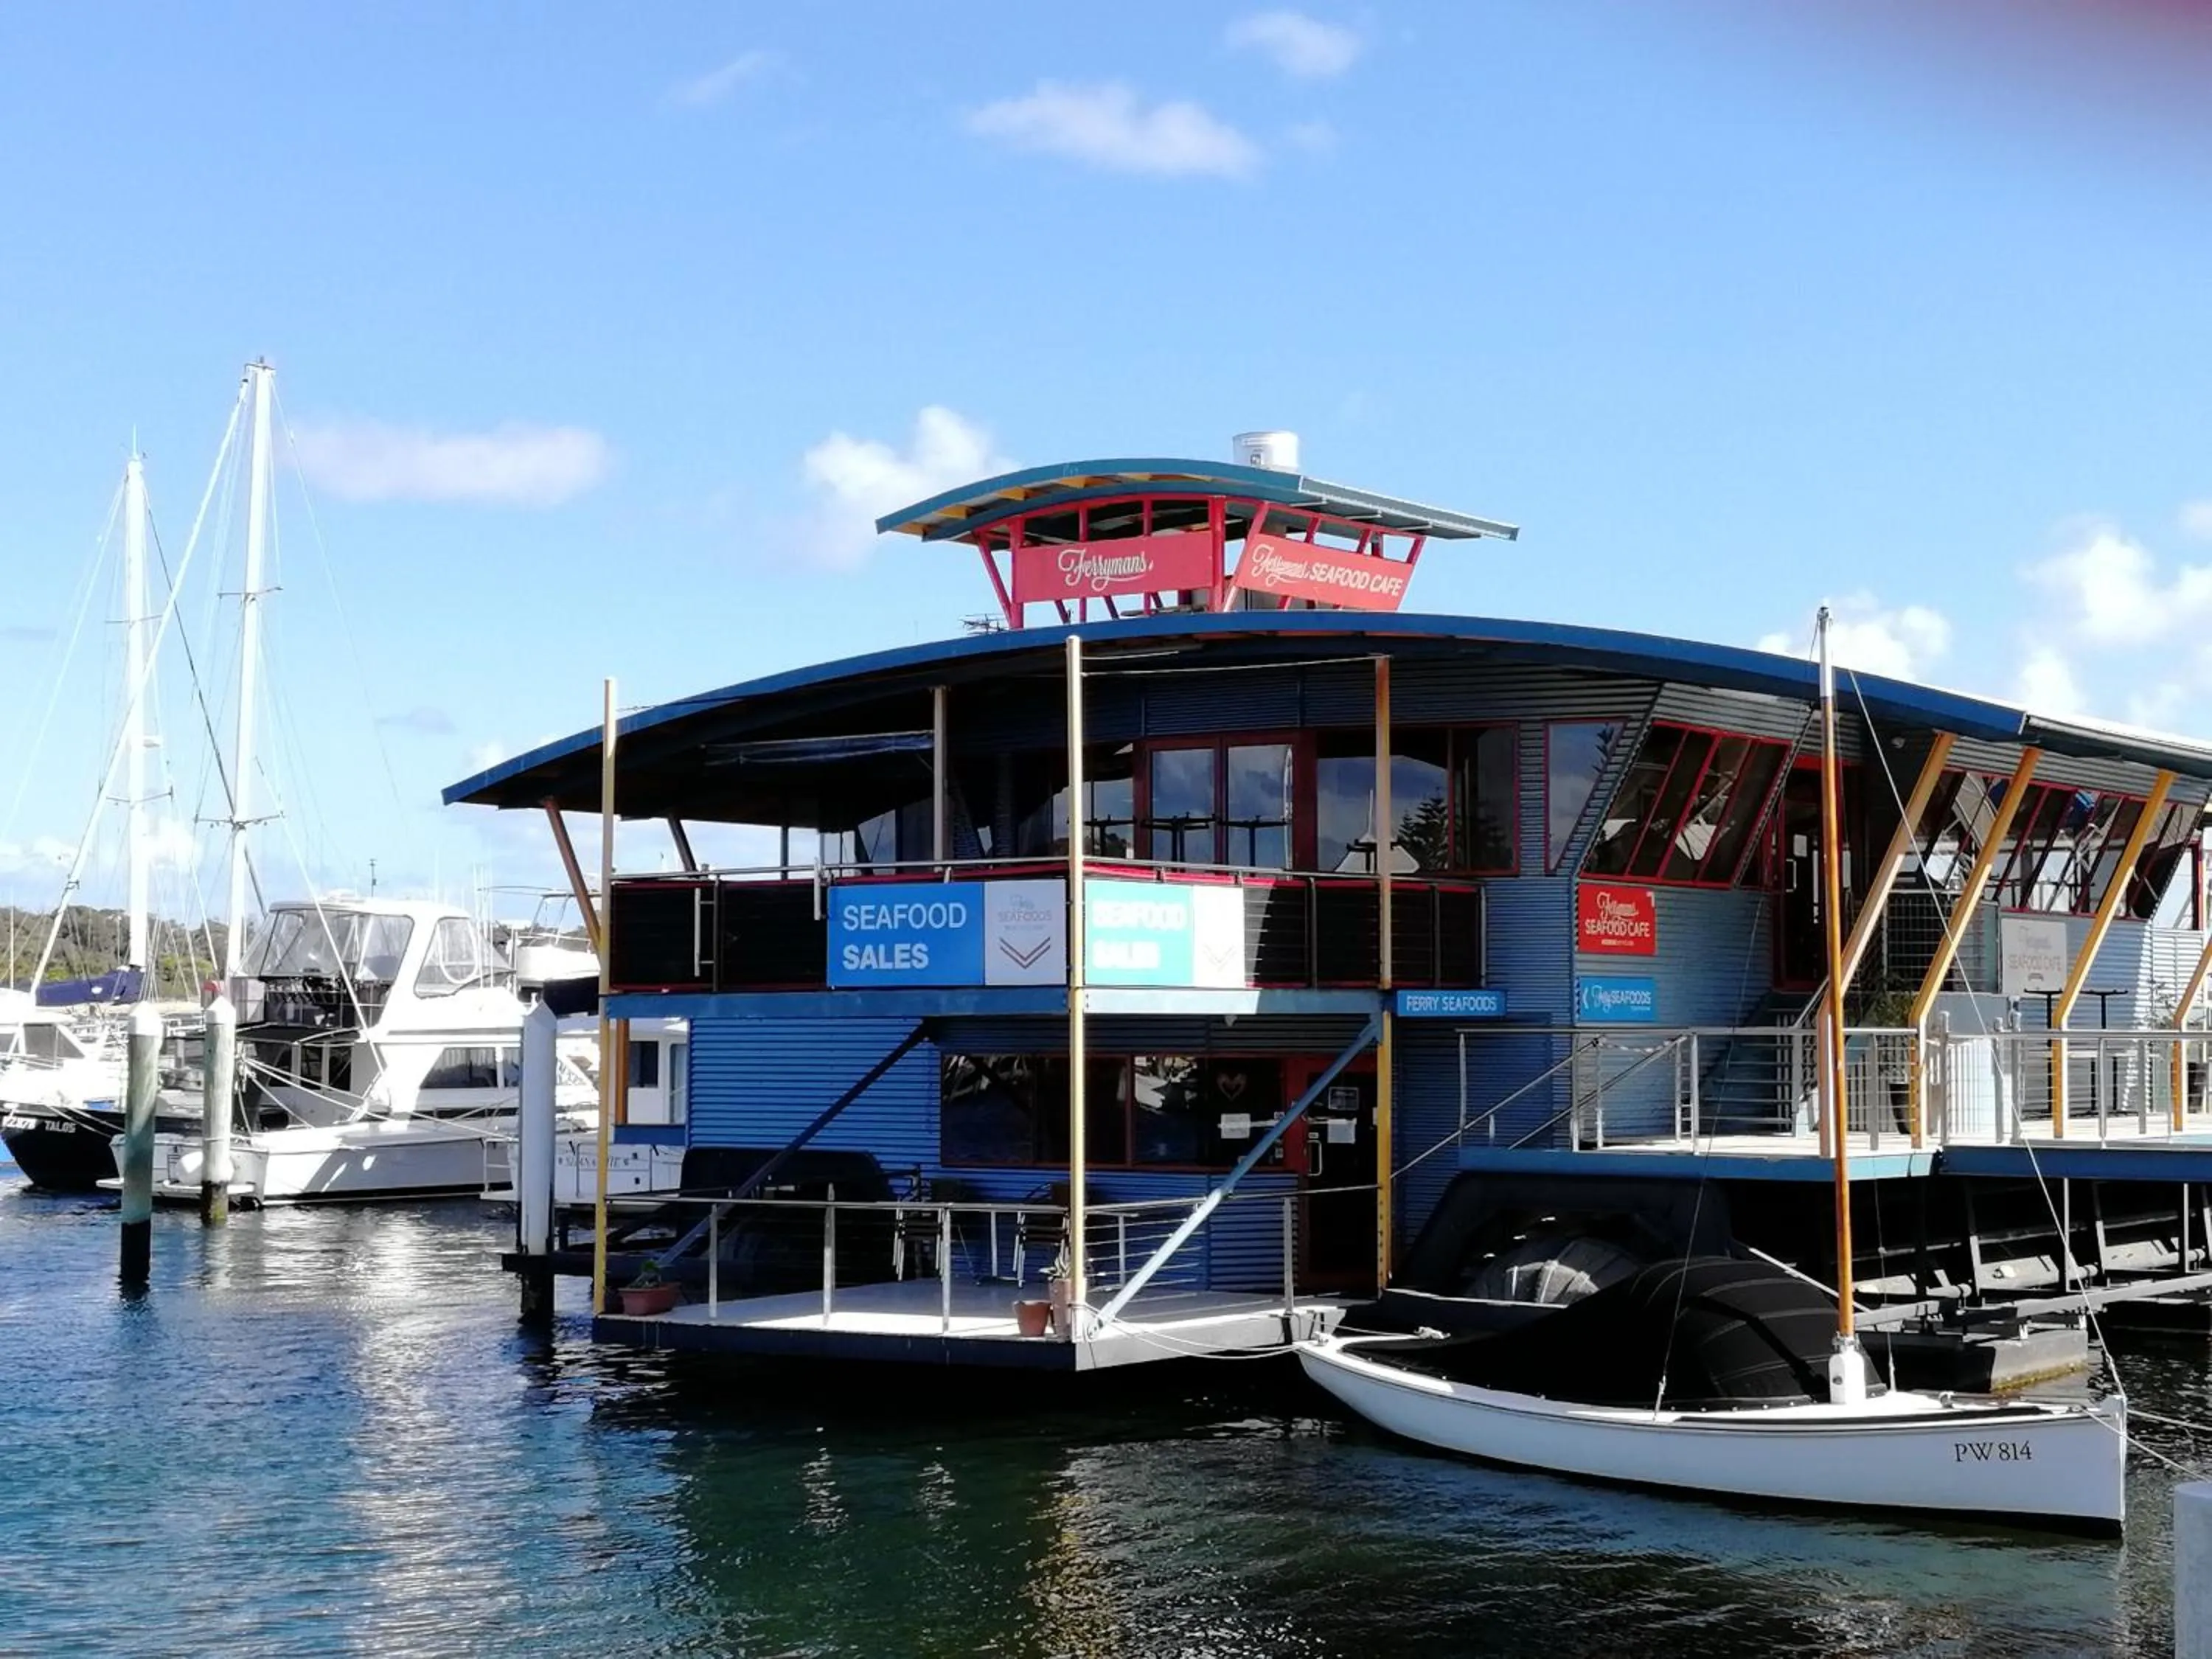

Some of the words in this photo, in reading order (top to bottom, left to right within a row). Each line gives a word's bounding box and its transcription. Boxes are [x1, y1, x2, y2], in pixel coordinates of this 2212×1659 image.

[1308, 562, 1370, 591] SEAFOOD
[1369, 574, 1404, 597] CAFE
[843, 902, 967, 931] SEAFOOD
[1585, 919, 1627, 936] SEAFOOD
[1627, 922, 1651, 938] CAFE
[842, 941, 930, 970] SALES
[1406, 995, 1440, 1012] FERRY
[1441, 996, 1498, 1012] SEAFOODS
[1954, 1441, 1993, 1462] PW
[1998, 1440, 2032, 1461] 814
